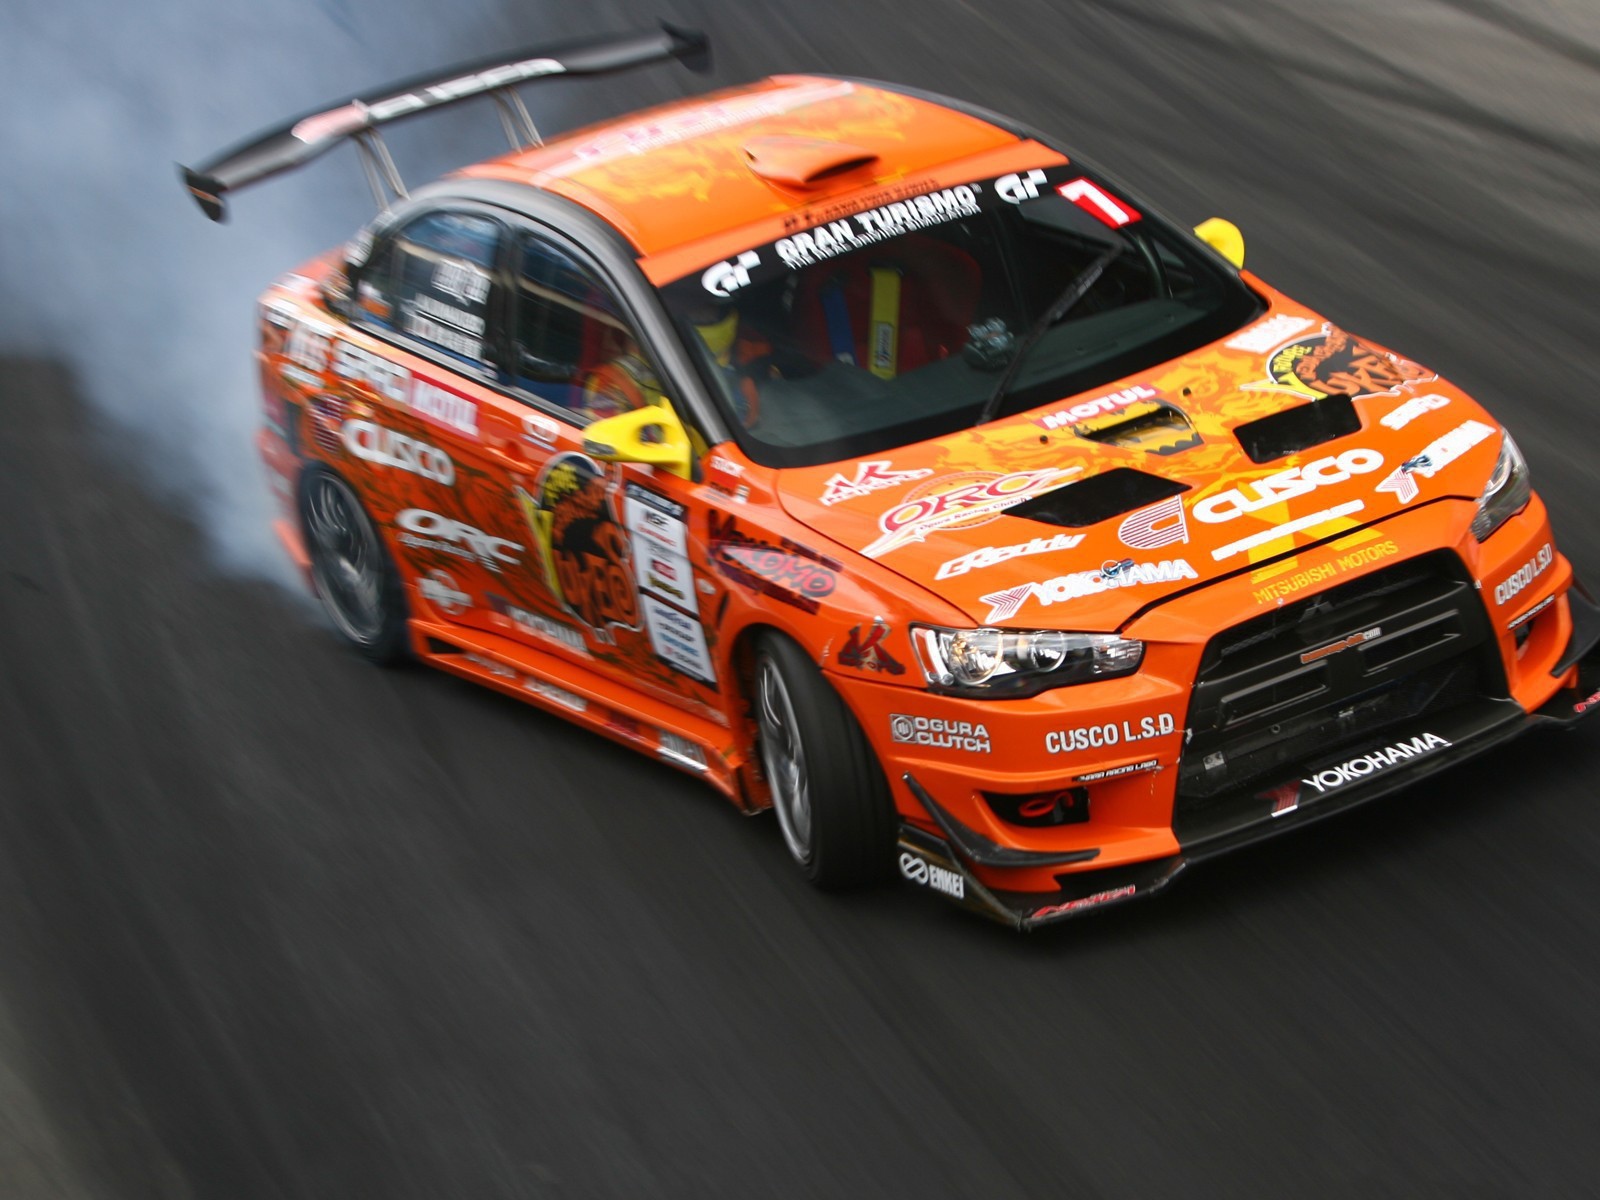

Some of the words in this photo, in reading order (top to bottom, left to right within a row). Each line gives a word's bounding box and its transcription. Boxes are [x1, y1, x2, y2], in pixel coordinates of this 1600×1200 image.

[1060, 179, 1129, 226] 1
[775, 219, 856, 260] GRAN
[1042, 385, 1156, 430] MOTUL
[341, 418, 456, 487] CUSCO
[1192, 448, 1384, 524] CUSCO
[395, 508, 527, 566] ORC
[1252, 561, 1336, 605] MITSUBISHI
[1339, 540, 1399, 572] MOTORS
[914, 716, 990, 738] OGURA
[915, 731, 991, 753] CLUTCH
[1045, 723, 1119, 754] CUSCO
[1123, 713, 1175, 742] L.S.D
[1301, 732, 1452, 793] YOKOHAMA
[929, 864, 964, 899] ENKEI
